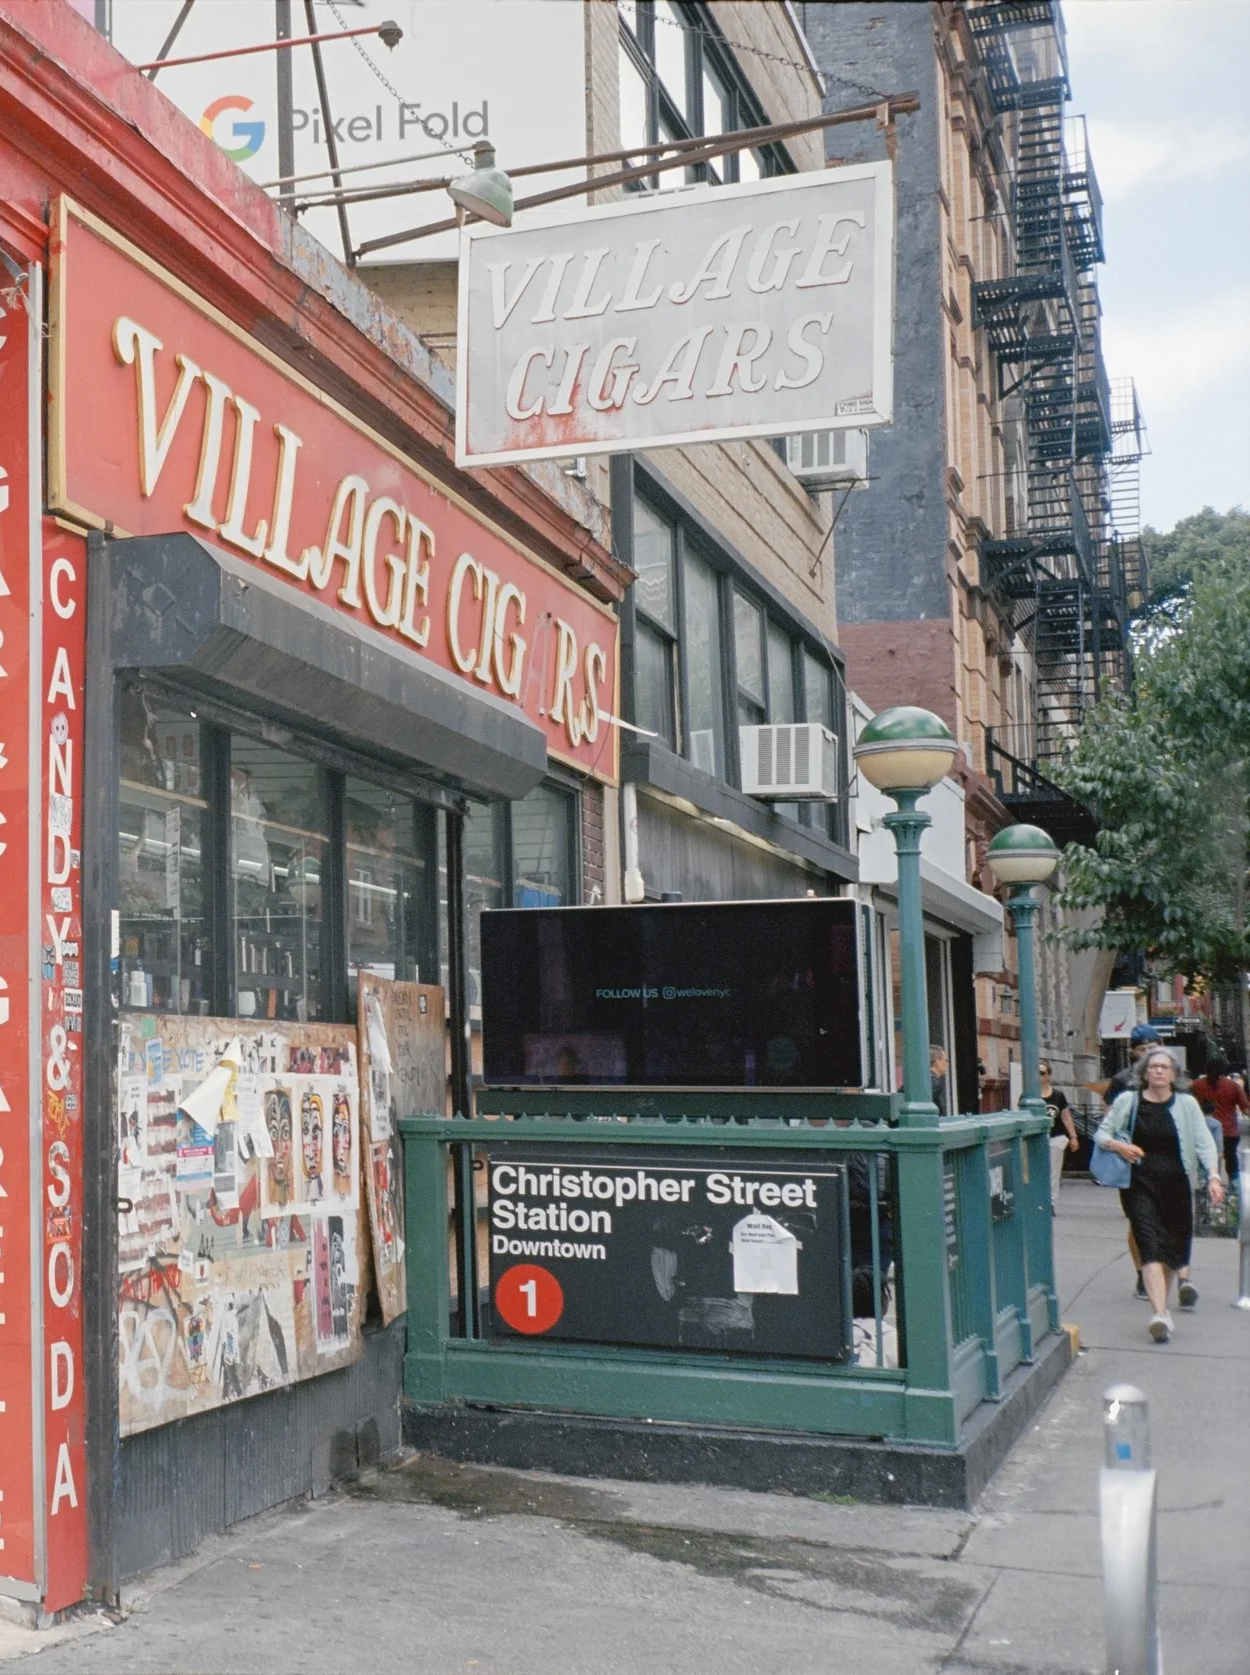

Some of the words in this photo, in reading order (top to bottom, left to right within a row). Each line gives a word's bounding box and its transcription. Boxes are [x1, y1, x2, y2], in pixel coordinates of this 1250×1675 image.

[399, 100, 489, 140] Fold
[486, 209, 866, 329] VILLAGE
[505, 311, 834, 422] CIGARS
[113, 316, 435, 649] VILLAGE
[596, 988, 641, 999] FOLLOW
[643, 988, 659, 998] US
[491, 1165, 695, 1207] Christopher
[706, 1172, 817, 1208] Street
[491, 1199, 612, 1234] Station
[492, 1235, 606, 1260] Downtown
[519, 1279, 538, 1317] 1
